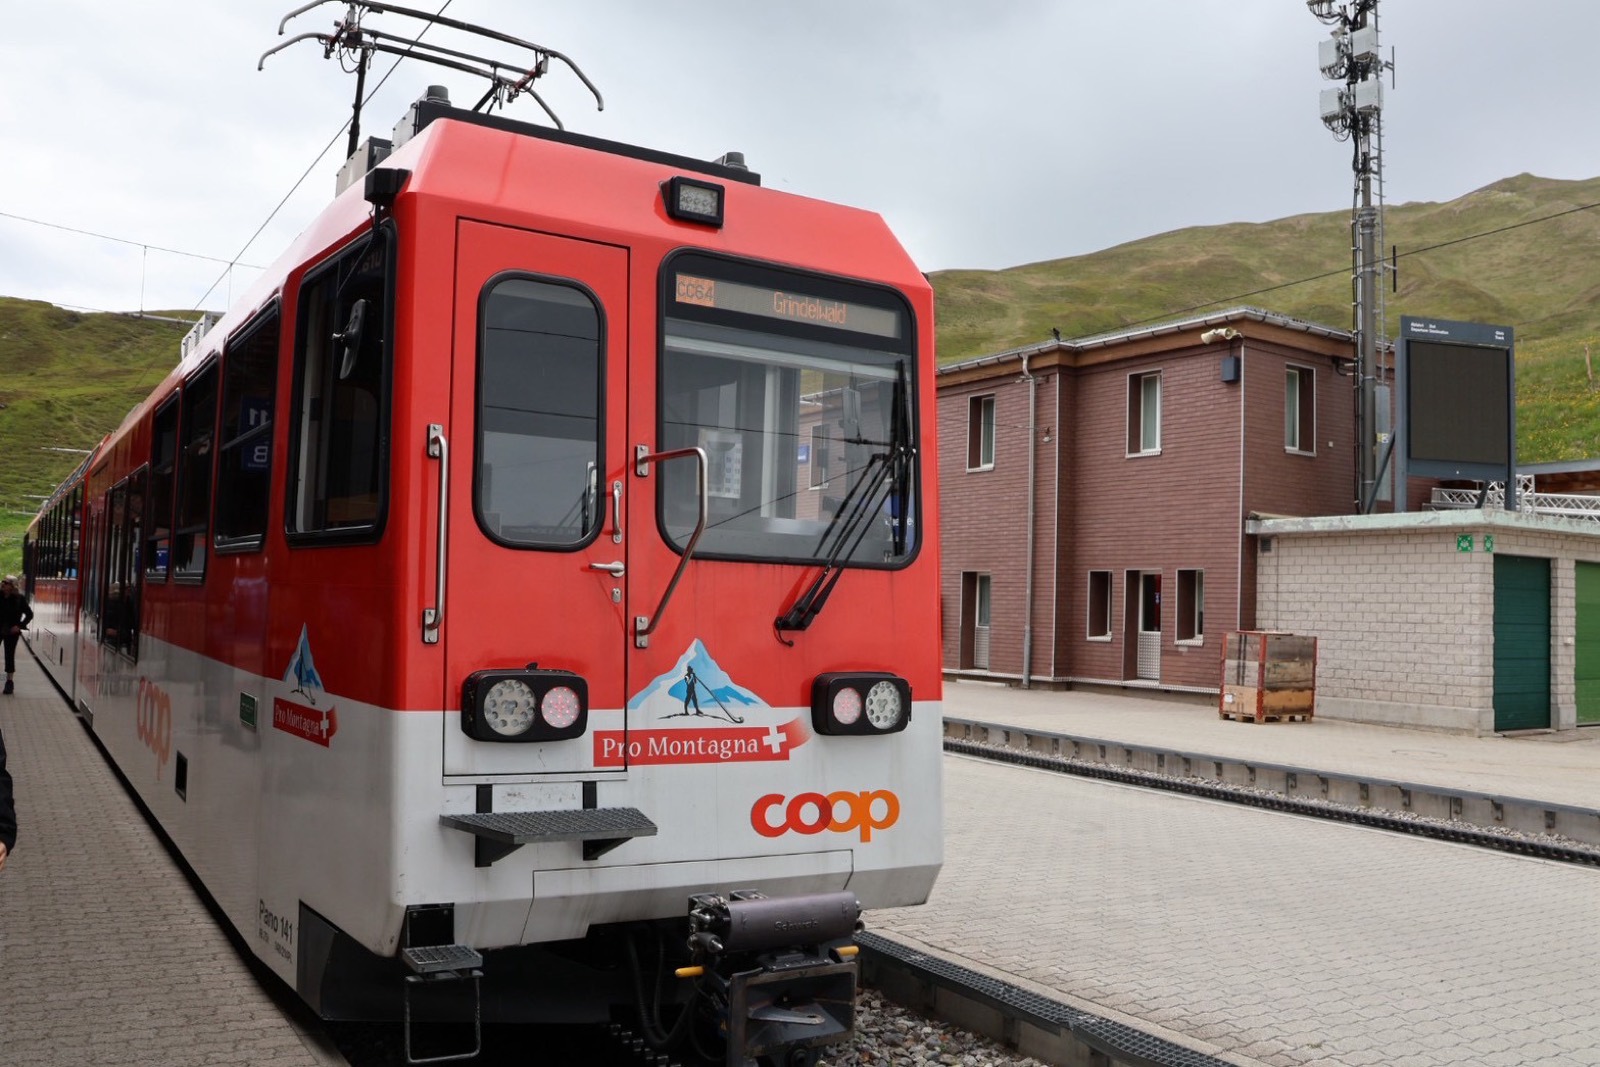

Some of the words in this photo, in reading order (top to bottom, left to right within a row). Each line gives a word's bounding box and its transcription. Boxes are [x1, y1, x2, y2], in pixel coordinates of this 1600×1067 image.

[773, 291, 847, 325] Grindelwald
[137, 676, 171, 781] coop
[274, 703, 286, 724] Pro
[286, 707, 320, 737] Montagna
[602, 737, 642, 758] Pro
[647, 735, 759, 759] Montagna
[750, 789, 901, 843] coop
[259, 899, 278, 932] Pano
[280, 916, 293, 945] 141
